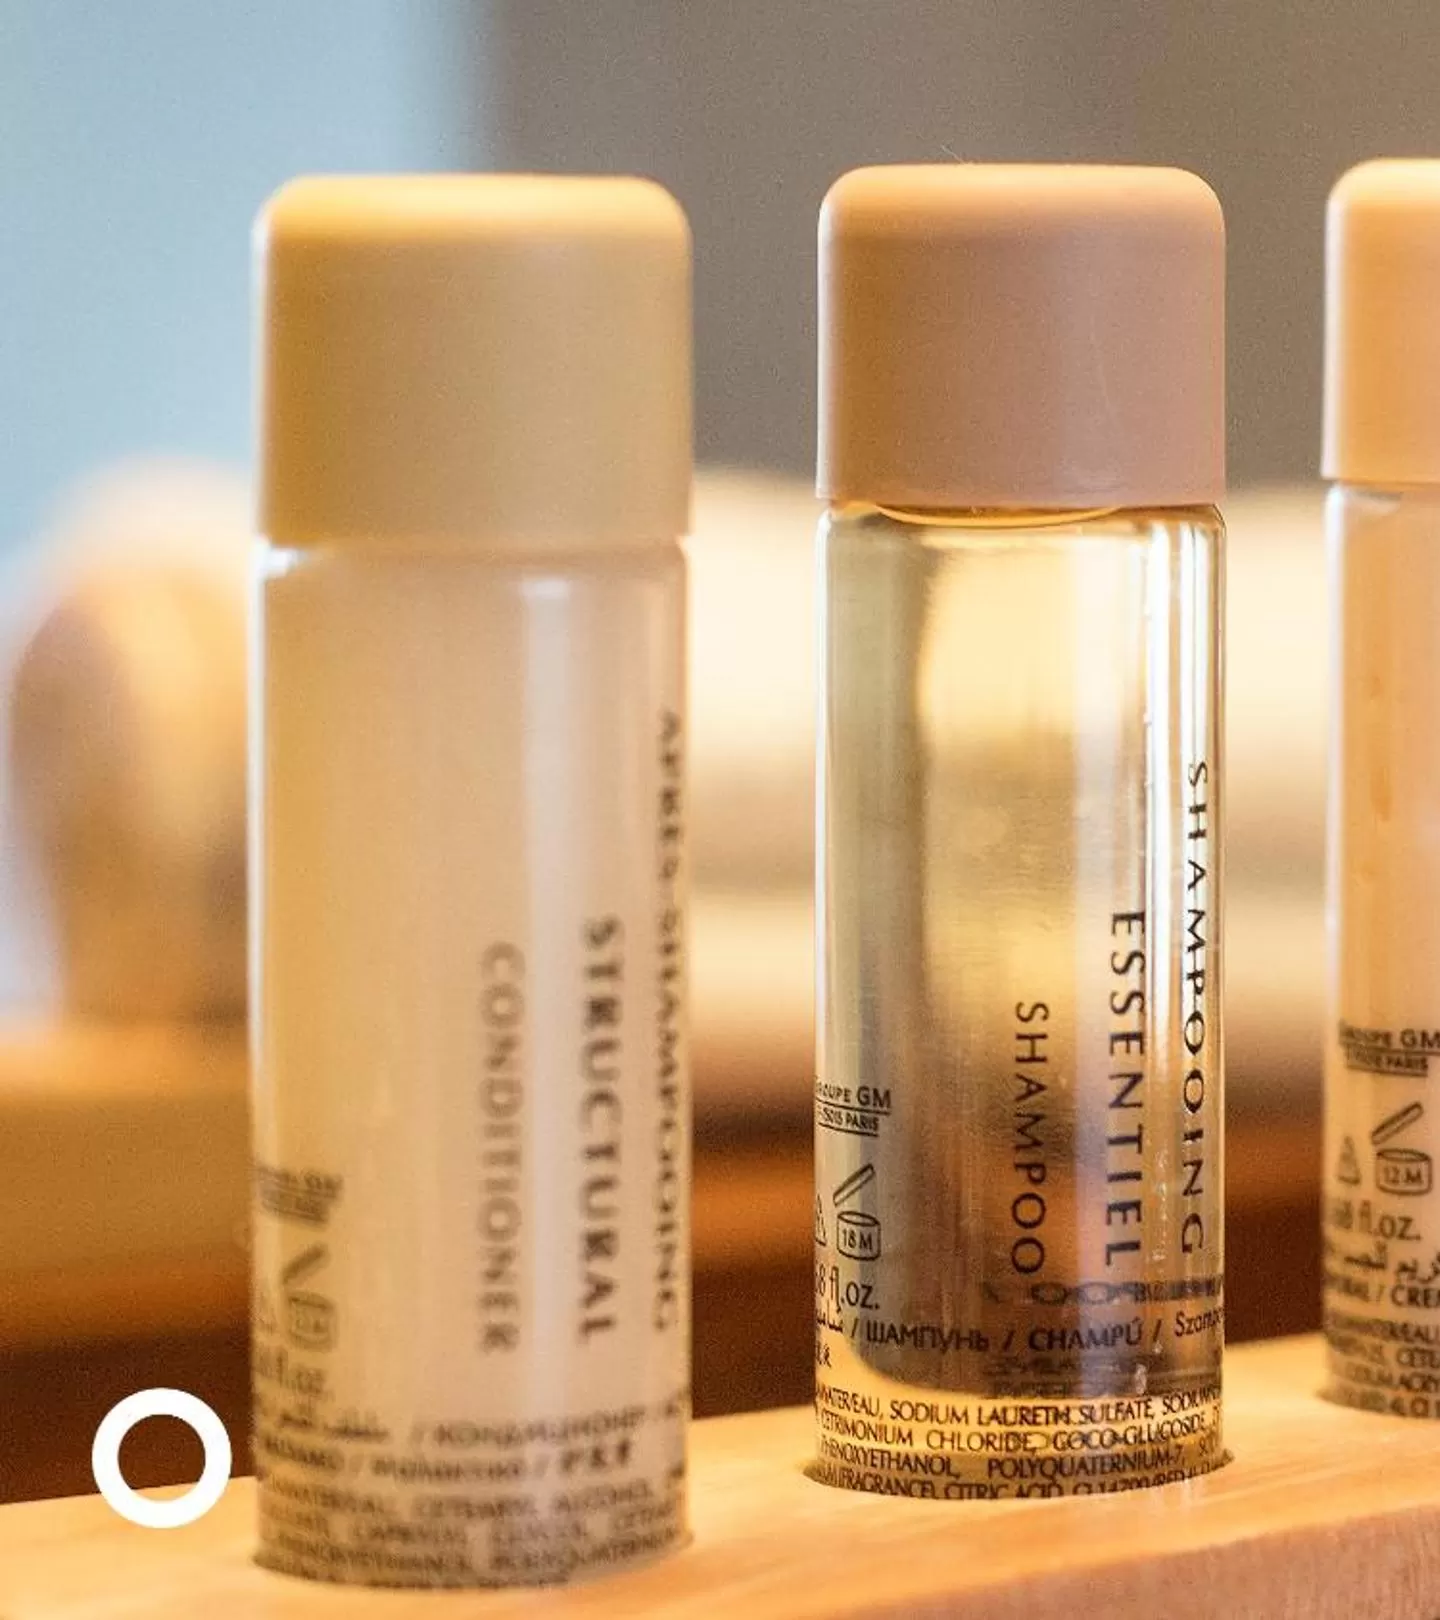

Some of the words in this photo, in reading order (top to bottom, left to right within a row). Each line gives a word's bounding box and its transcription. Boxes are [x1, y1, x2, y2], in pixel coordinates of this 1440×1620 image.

[1181, 762, 1208, 1254] SHAMPOOING
[477, 941, 527, 1353] CONDITIONER
[577, 914, 625, 1348] STRUCTURAL
[845, 1111, 879, 1132] PARIS
[857, 1085, 892, 1109] GM
[1010, 1001, 1050, 1275] SHAMPOO
[1105, 910, 1146, 1266] ESSENTIEL
[866, 1319, 991, 1353] ШАМПУНЬ
[1028, 1316, 1143, 1351] CHAMPÚ
[890, 1399, 969, 1426] SODIUM
[977, 1405, 1071, 1427] LAURETH
